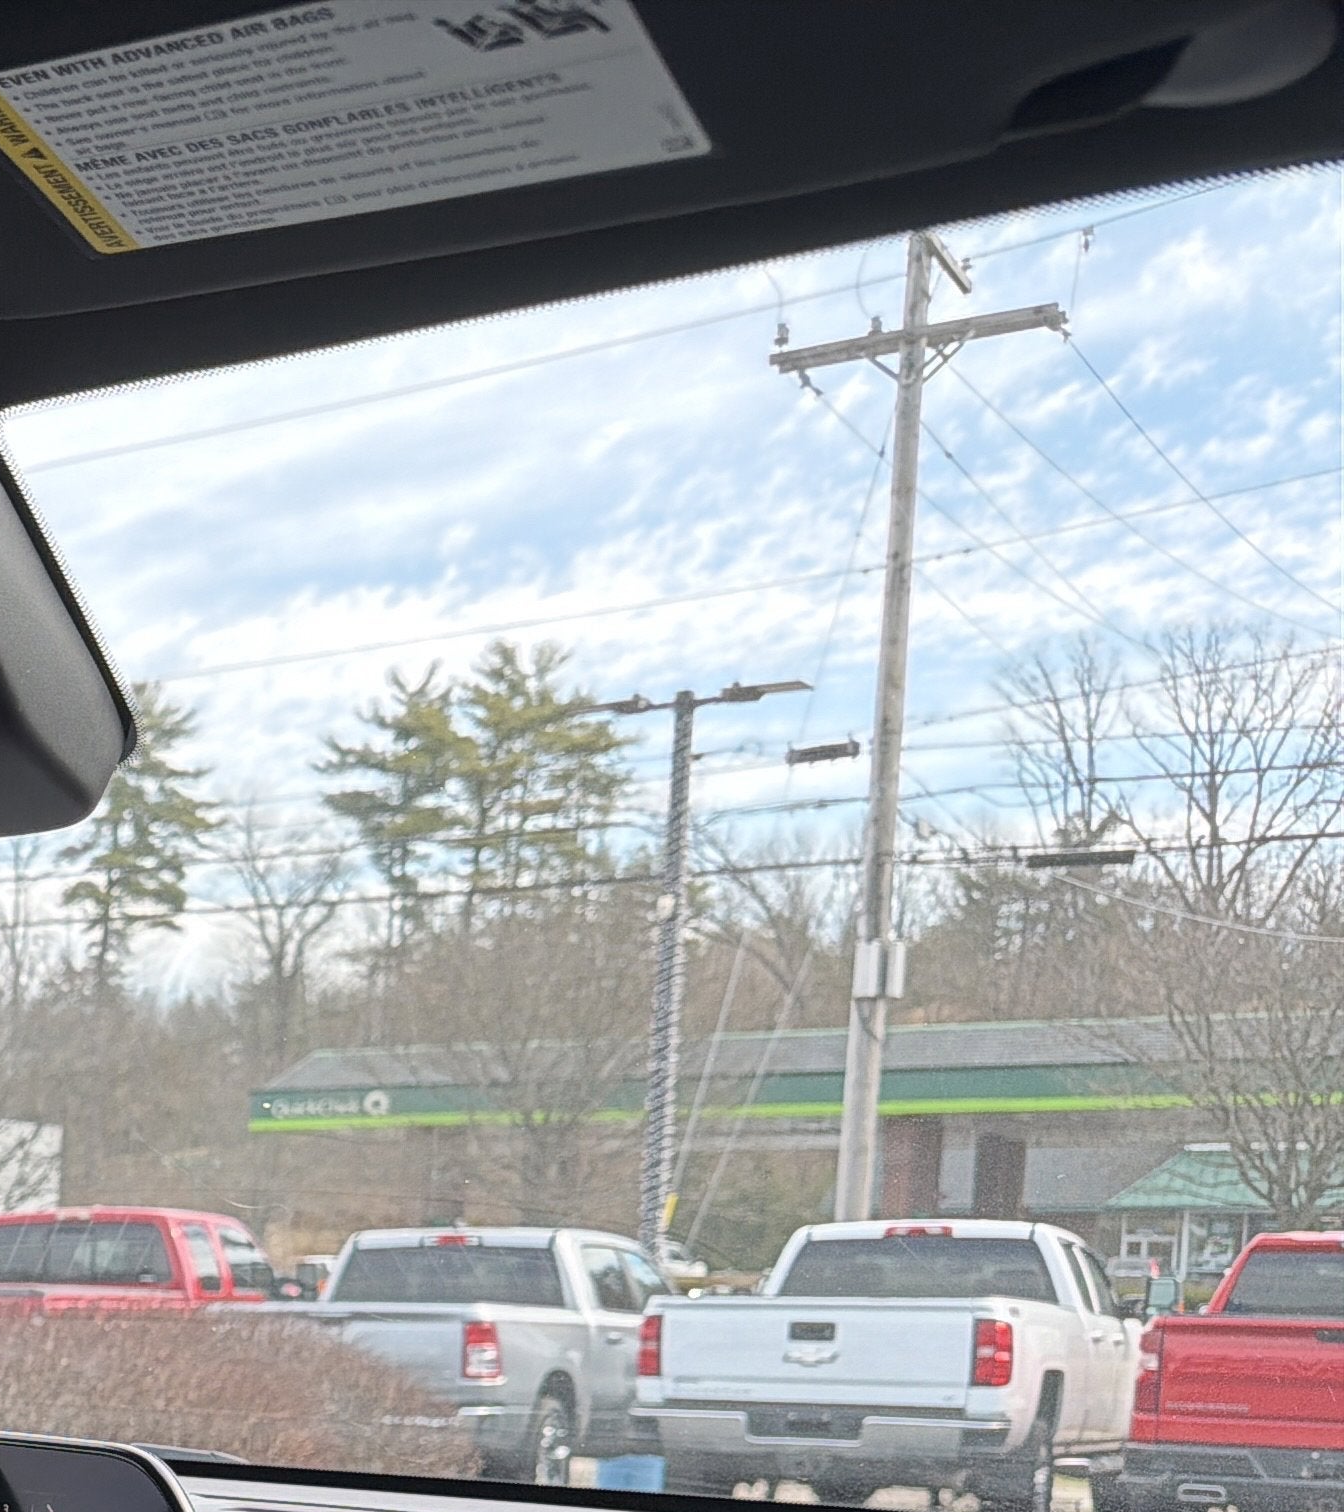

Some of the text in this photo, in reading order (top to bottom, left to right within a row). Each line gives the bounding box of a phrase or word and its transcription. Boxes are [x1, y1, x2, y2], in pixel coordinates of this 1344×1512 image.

[51, 57, 107, 77] WITH
[111, 31, 224, 66] ADVANCED
[136, 145, 182, 163] AVEC
[186, 138, 223, 154] DES
[226, 127, 279, 146] SACS
[283, 101, 411, 136] GONFLABLES
[32, 163, 127, 248] AVERTISSEMENT
